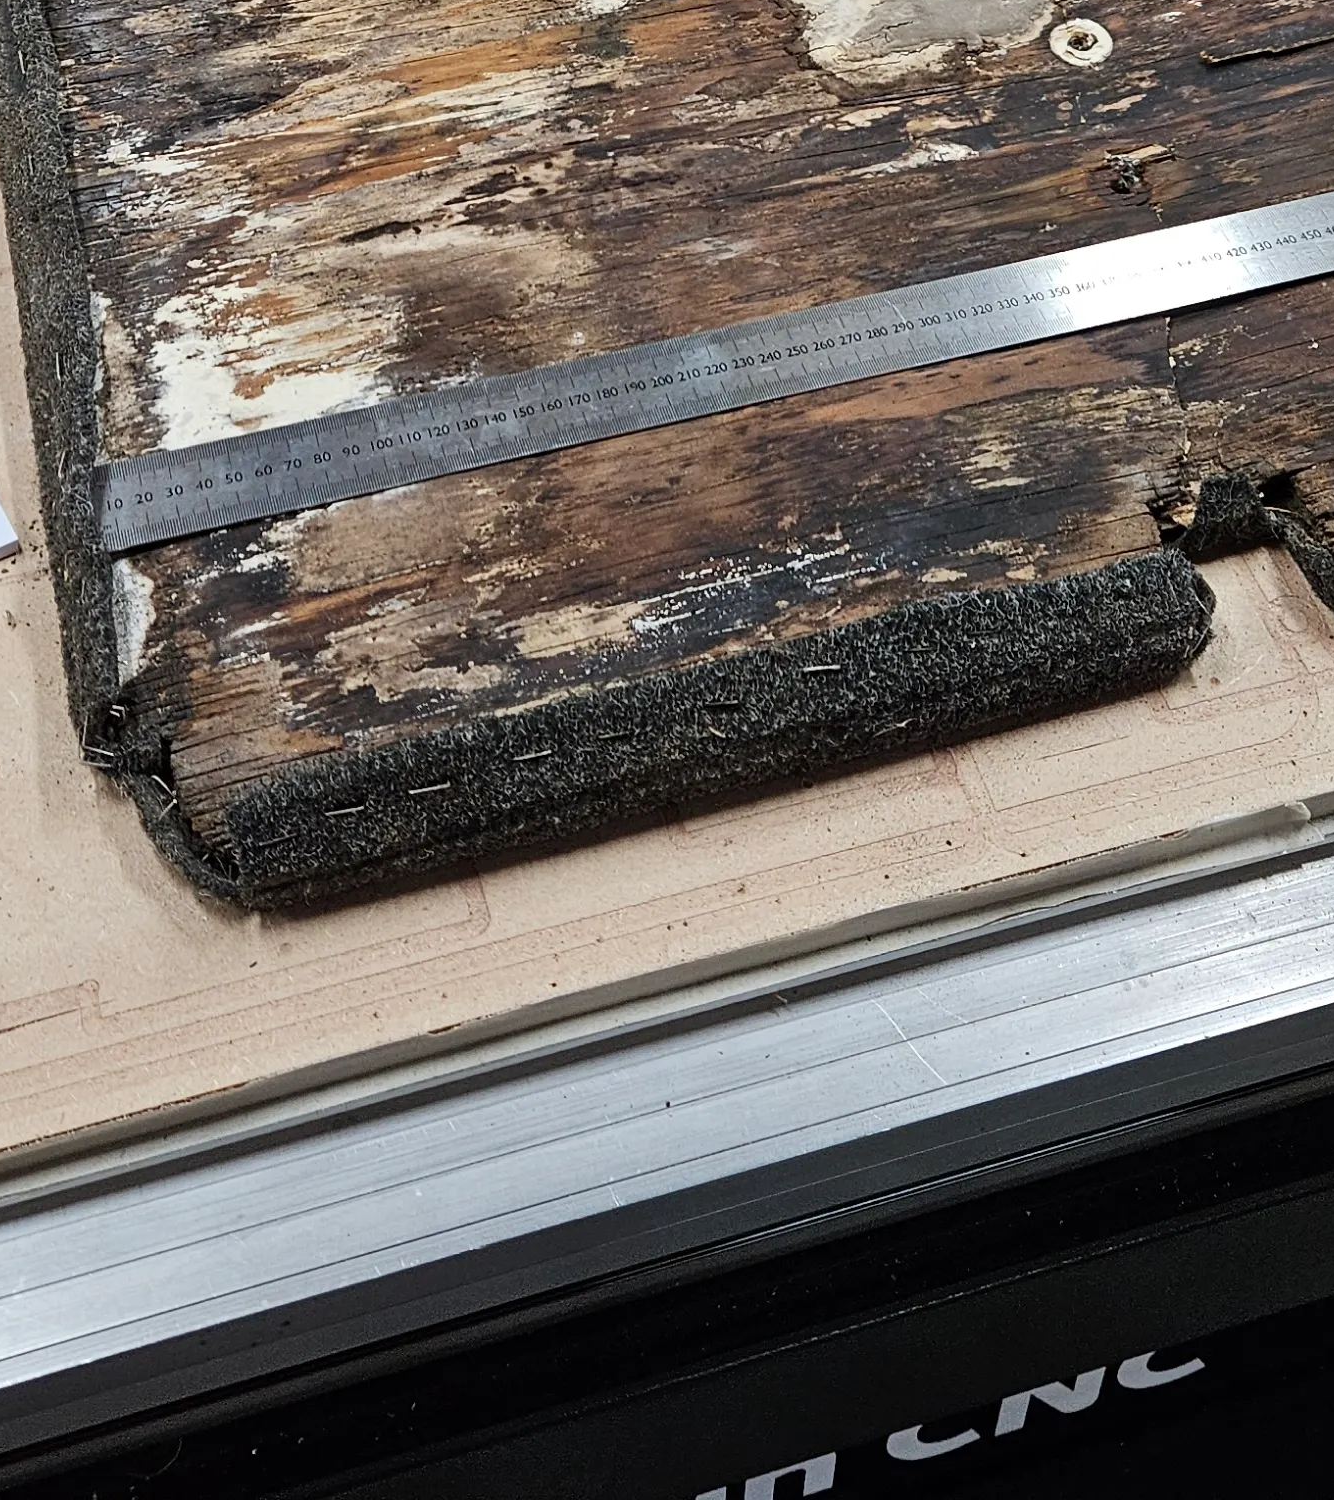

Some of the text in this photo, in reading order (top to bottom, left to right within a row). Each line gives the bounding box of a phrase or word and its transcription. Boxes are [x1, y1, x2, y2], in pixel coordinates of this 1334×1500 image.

[106, 498, 123, 511] 10
[135, 492, 153, 504] 20
[165, 485, 184, 498] 30
[196, 479, 213, 491] 40
[225, 472, 243, 484] 50
[255, 465, 273, 478] 60
[284, 458, 302, 471] 70
[313, 452, 331, 464] 80
[342, 445, 360, 457] 90
[370, 437, 393, 452] 100
[399, 431, 421, 445] 110
[427, 424, 450, 438] 120
[456, 418, 478, 431] 130
[484, 412, 506, 425] 140
[513, 405, 535, 419] 150
[541, 399, 562, 412] 160
[569, 393, 591, 406] 170
[597, 386, 618, 400] 180
[624, 380, 646, 394] 190
[652, 374, 673, 388] 200
[678, 368, 700, 381] 210
[705, 362, 727, 375] 220
[732, 356, 754, 369] 230
[759, 350, 781, 363] 240
[786, 344, 808, 357] 250
[813, 338, 835, 351] 260
[840, 332, 861, 345] 270
[866, 326, 888, 339] 280
[893, 320, 914, 334] 290
[918, 314, 941, 327] 300
[945, 308, 967, 322] 310
[971, 303, 993, 316] 320
[997, 297, 1019, 310] 330
[1023, 292, 1045, 305] 340
[1049, 286, 1070, 298] 350
[1226, 246, 1247, 258] 420
[1250, 240, 1272, 252] 430
[1275, 234, 1297, 246] 440
[1300, 228, 1321, 240] 450
